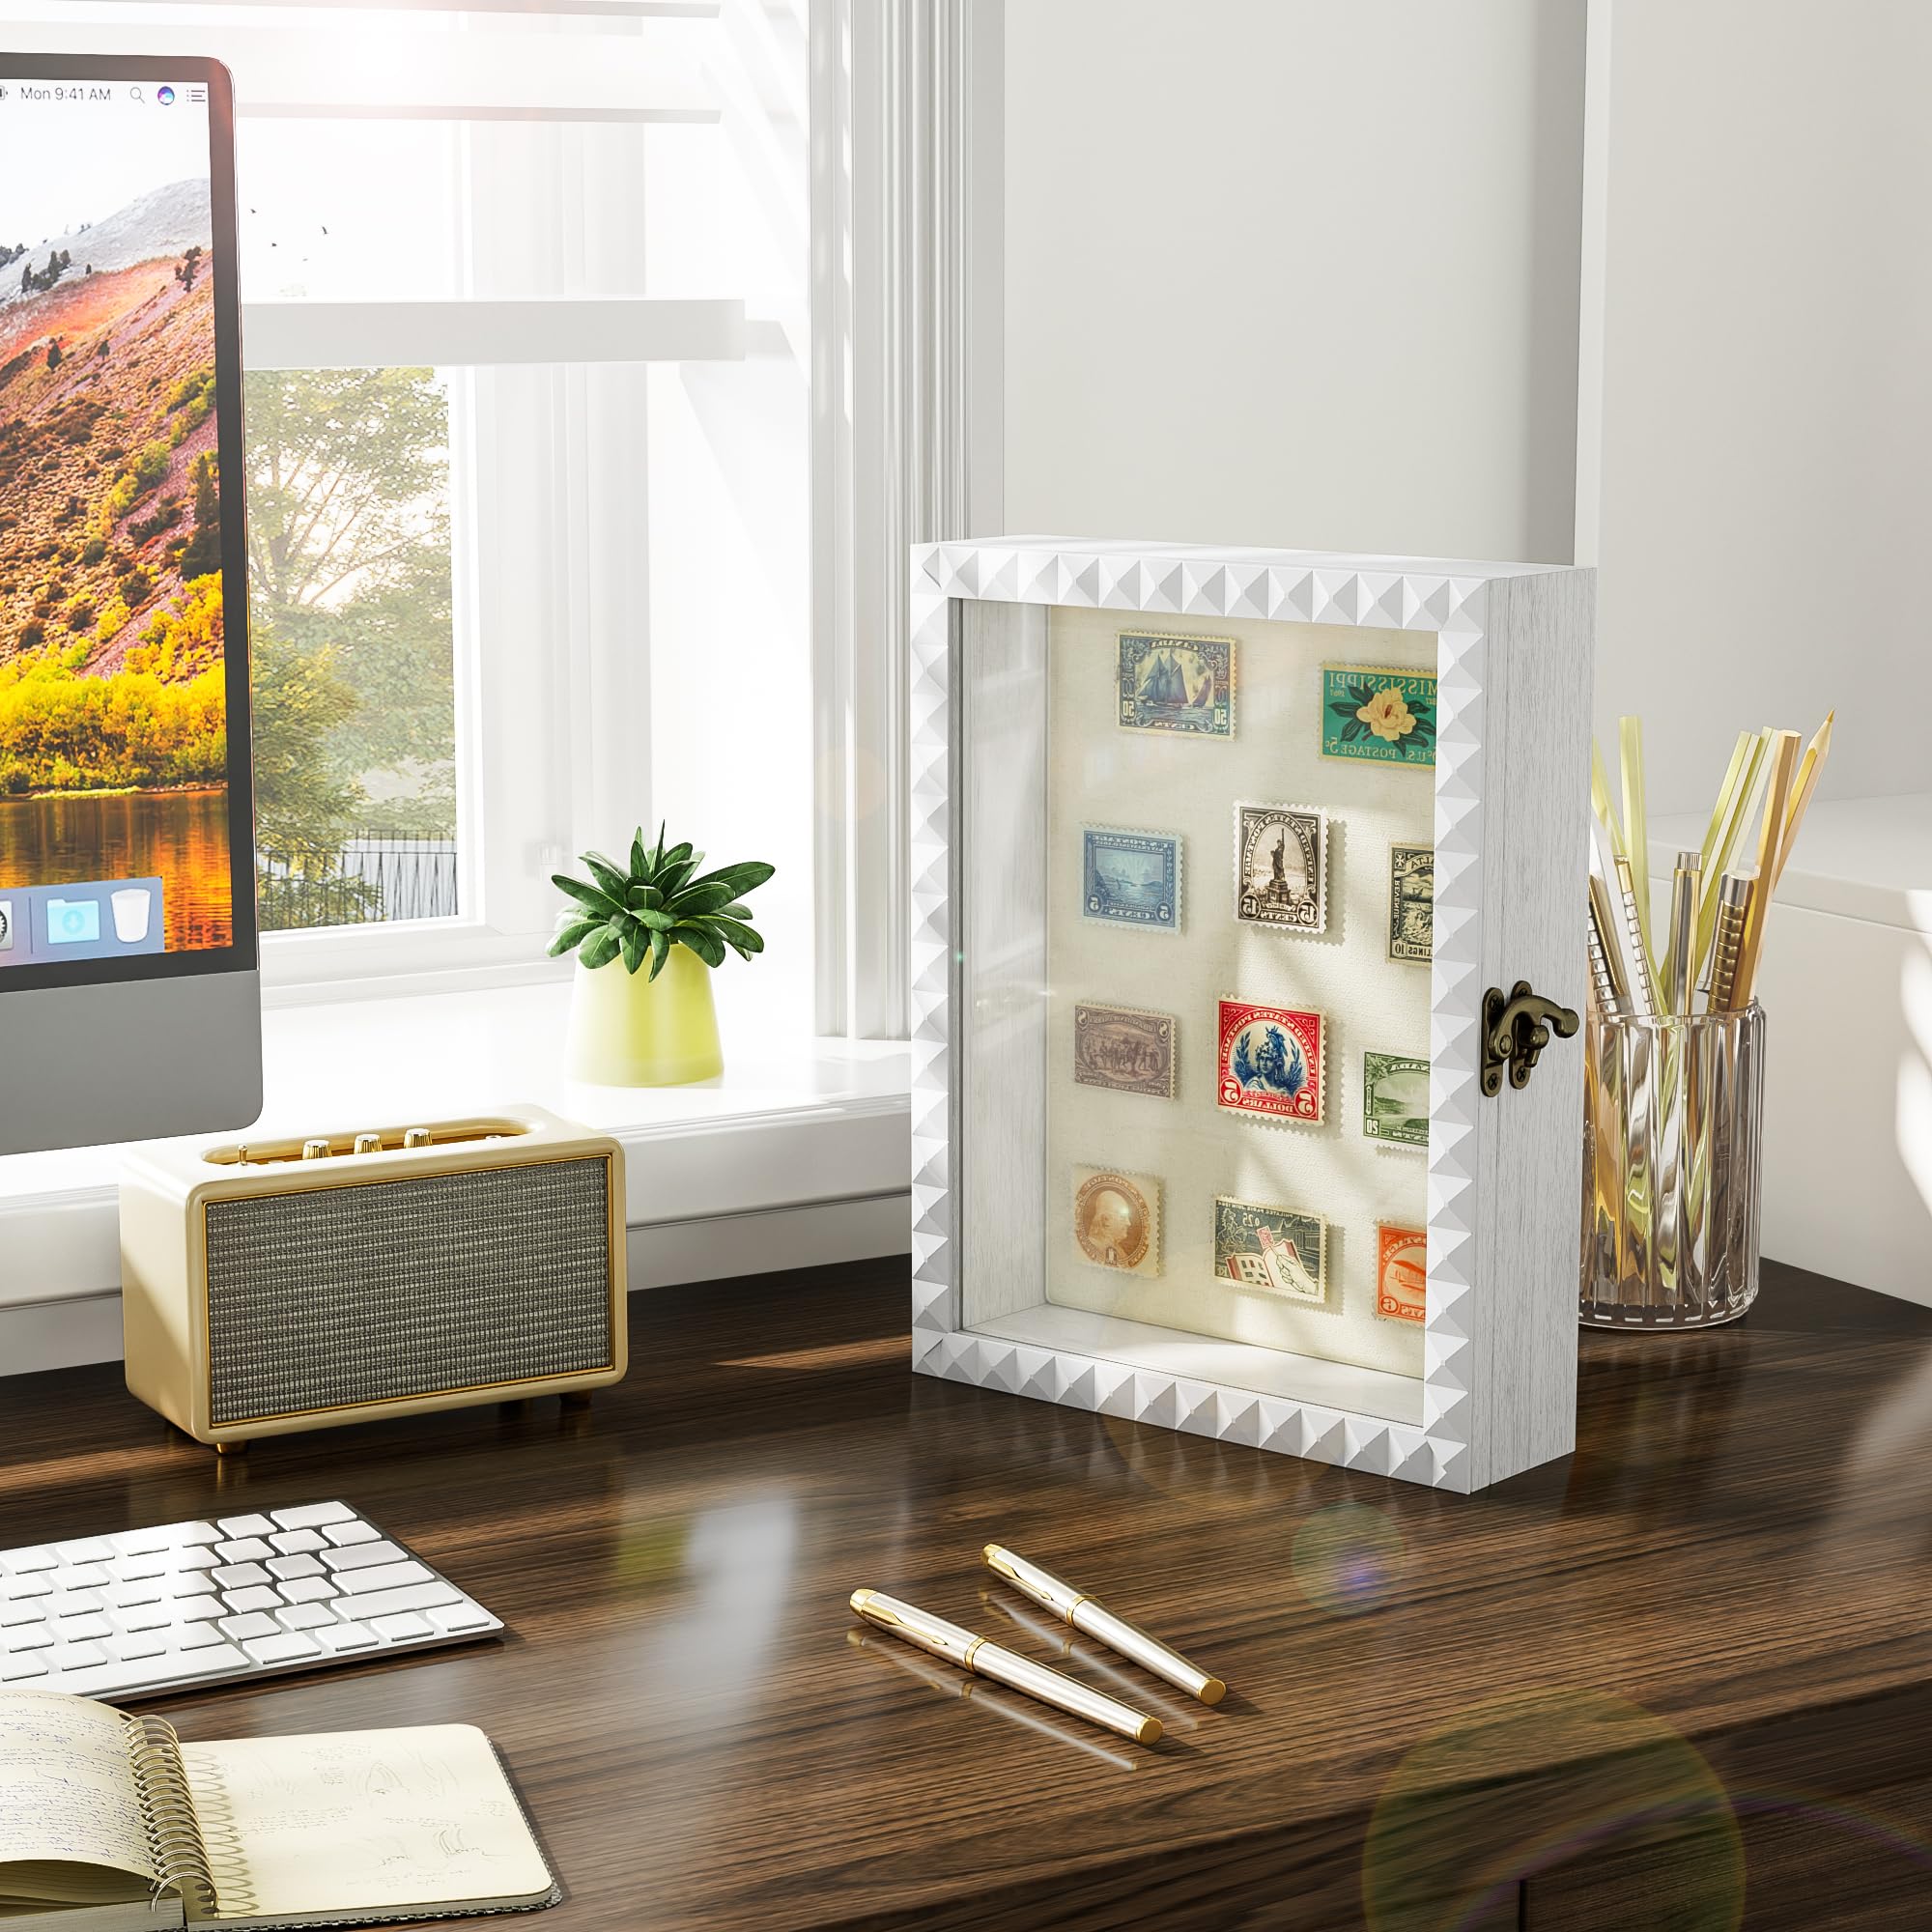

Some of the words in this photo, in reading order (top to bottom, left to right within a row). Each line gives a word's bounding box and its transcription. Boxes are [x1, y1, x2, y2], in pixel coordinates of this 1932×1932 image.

[20, 87, 51, 100] Mon
[55, 87, 84, 101] 9:41
[89, 88, 111, 100] AM
